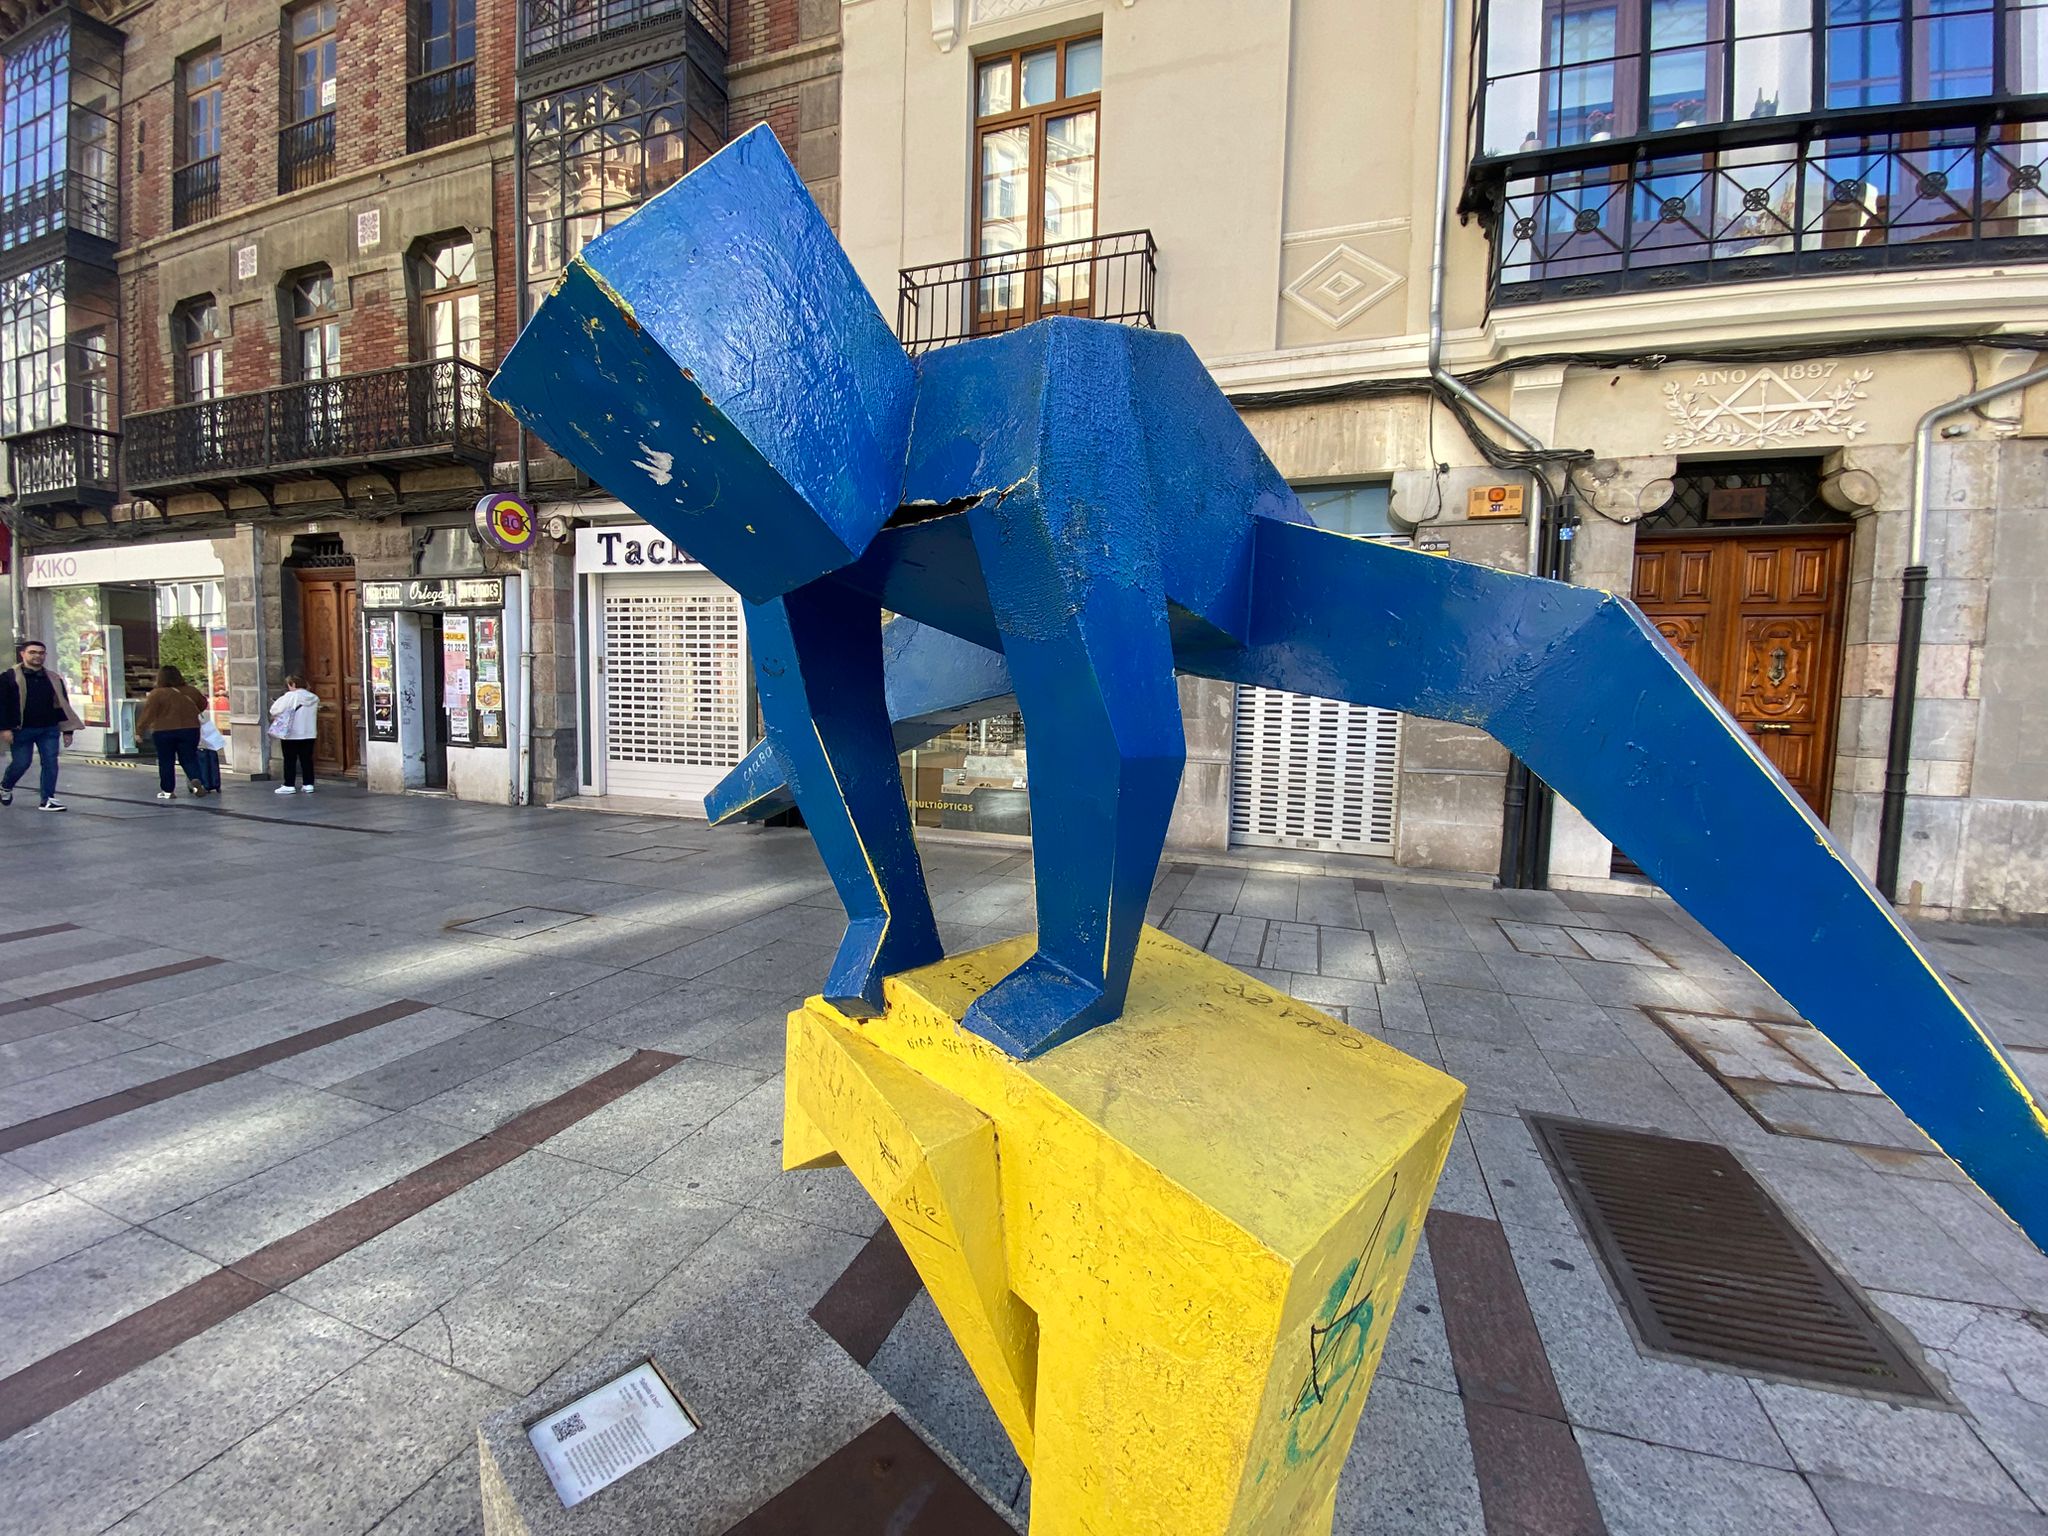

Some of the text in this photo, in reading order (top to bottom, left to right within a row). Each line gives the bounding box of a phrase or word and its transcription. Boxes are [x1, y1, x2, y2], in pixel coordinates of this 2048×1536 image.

[1782, 362, 1839, 380] 1897
[36, 556, 77, 578] KIKO
[409, 581, 446, 607] Ortega
